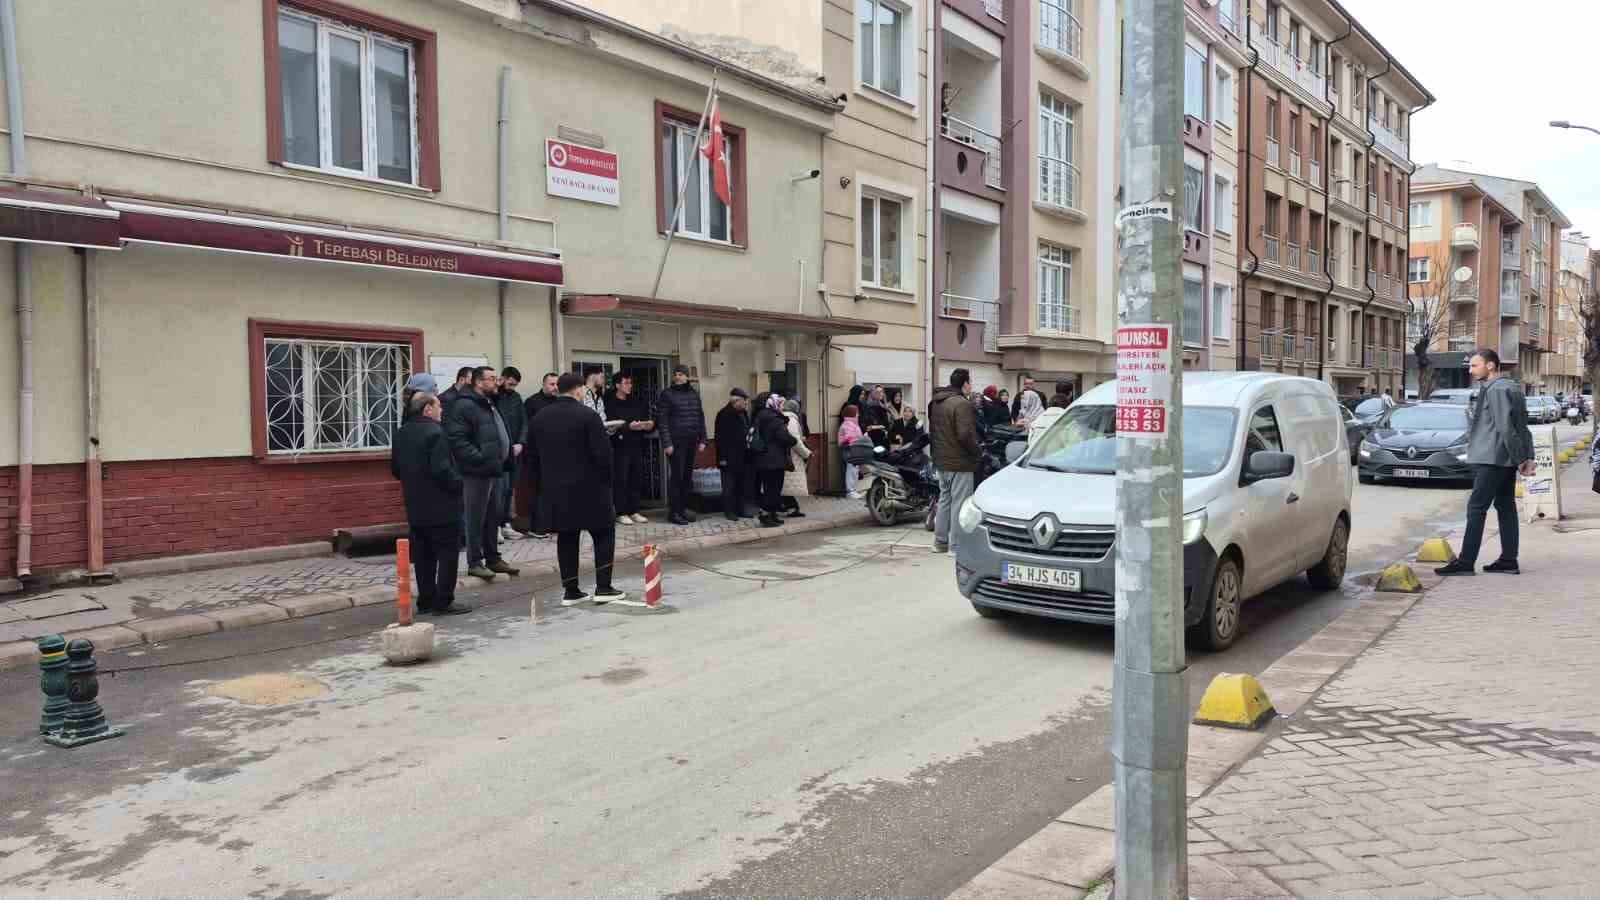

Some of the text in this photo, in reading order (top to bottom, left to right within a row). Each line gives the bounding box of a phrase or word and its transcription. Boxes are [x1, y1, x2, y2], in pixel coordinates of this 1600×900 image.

[313, 239, 458, 271] TEPEBAŞI BELEDİYESİ
[1143, 409, 1161, 419] 26
[1143, 420, 1161, 431] 53
[1009, 566, 1076, 586] 34 HJS 405
